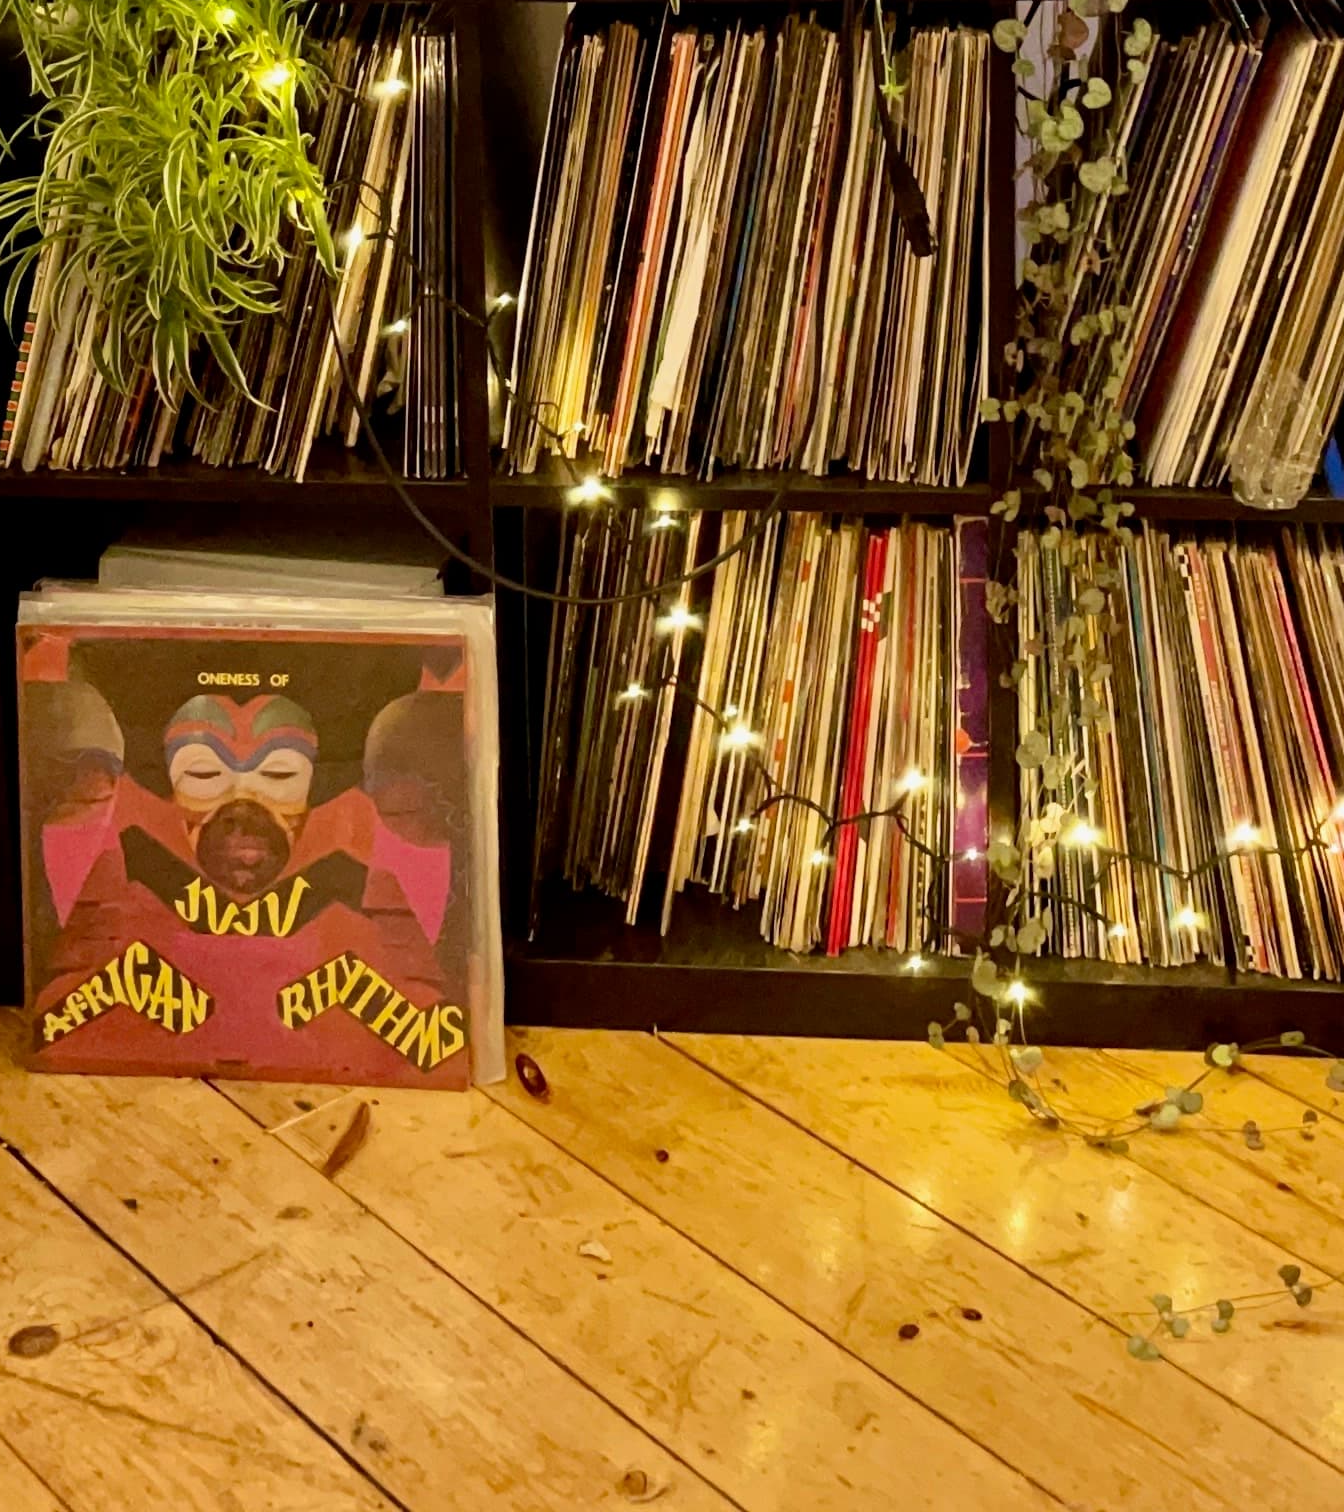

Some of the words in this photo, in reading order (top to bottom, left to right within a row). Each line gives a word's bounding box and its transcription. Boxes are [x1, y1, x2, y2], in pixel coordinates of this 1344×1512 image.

[197, 672, 260, 687] ONENESS
[269, 674, 290, 687] OF
[174, 876, 312, 937] JUJU
[43, 941, 210, 1043] AFRICAN
[279, 954, 465, 1070] RHYTHMS
